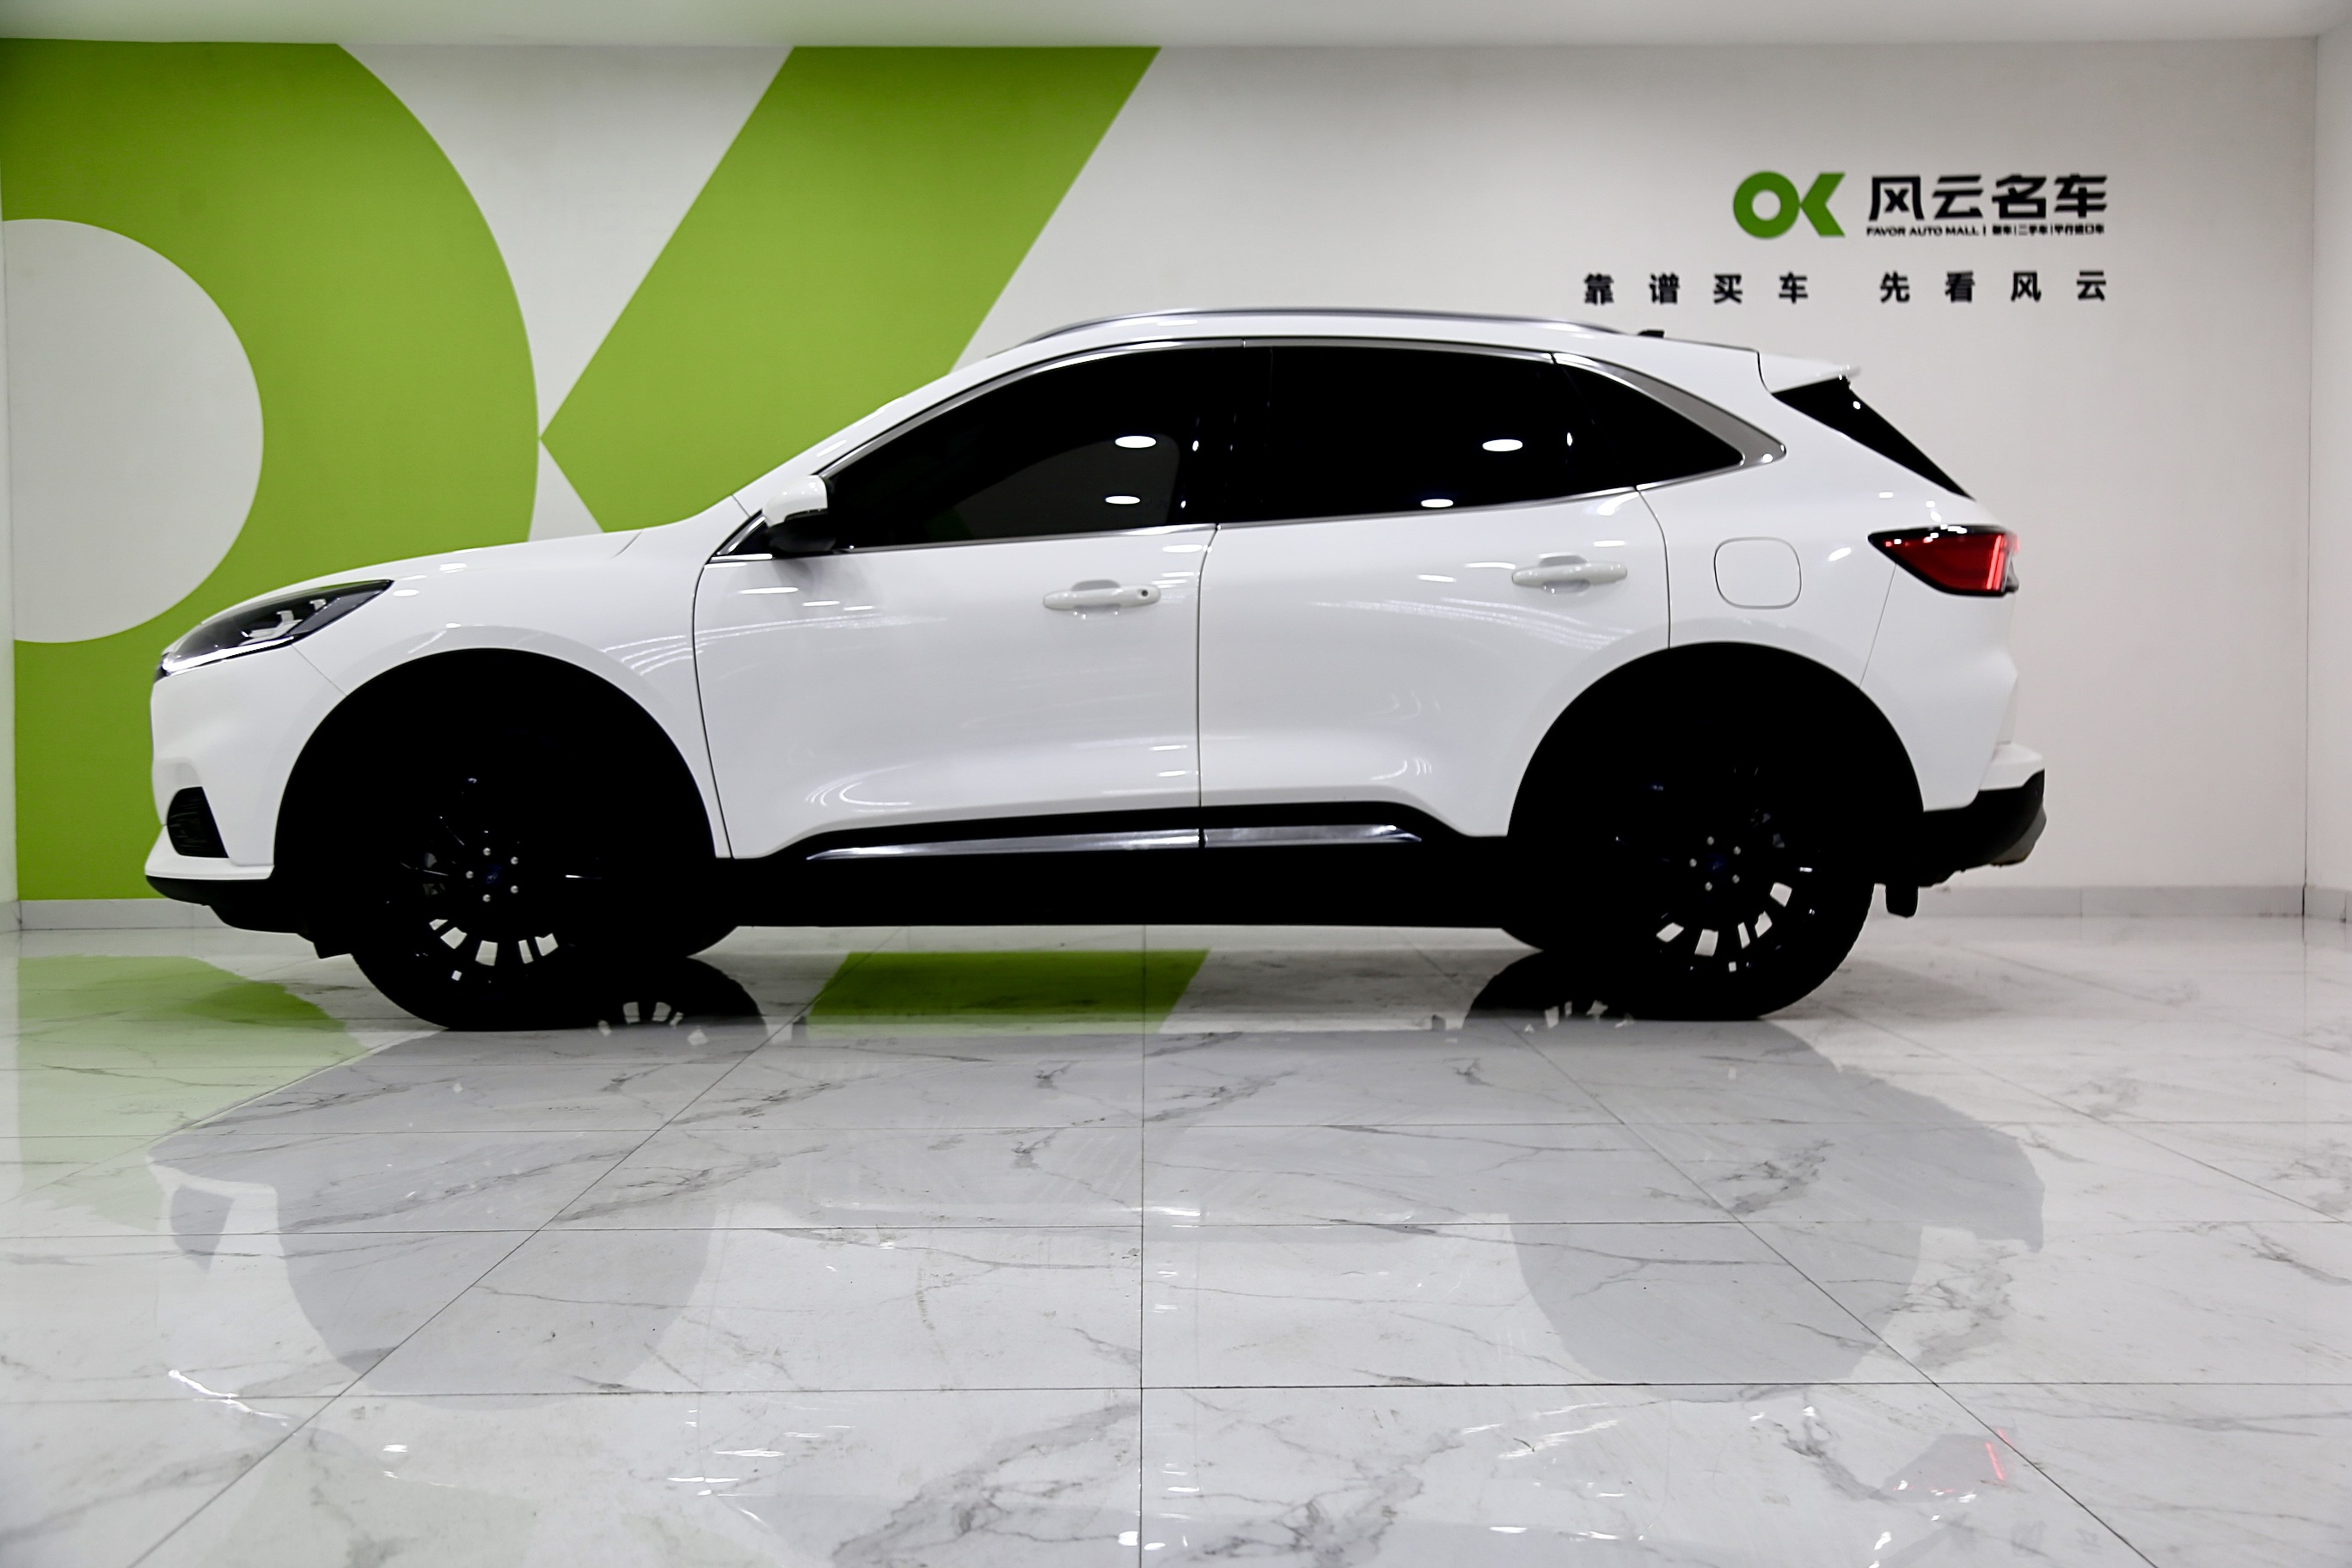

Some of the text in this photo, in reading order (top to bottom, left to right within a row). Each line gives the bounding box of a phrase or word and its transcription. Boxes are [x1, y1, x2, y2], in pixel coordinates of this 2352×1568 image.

[1733, 171, 2108, 239] OK 风云名车
[1866, 225, 1906, 236] FAVOR
[1909, 225, 1943, 236] AUTO
[1945, 224, 1980, 236] MALL
[1584, 270, 2106, 304] 靠谱买车 先看风云
